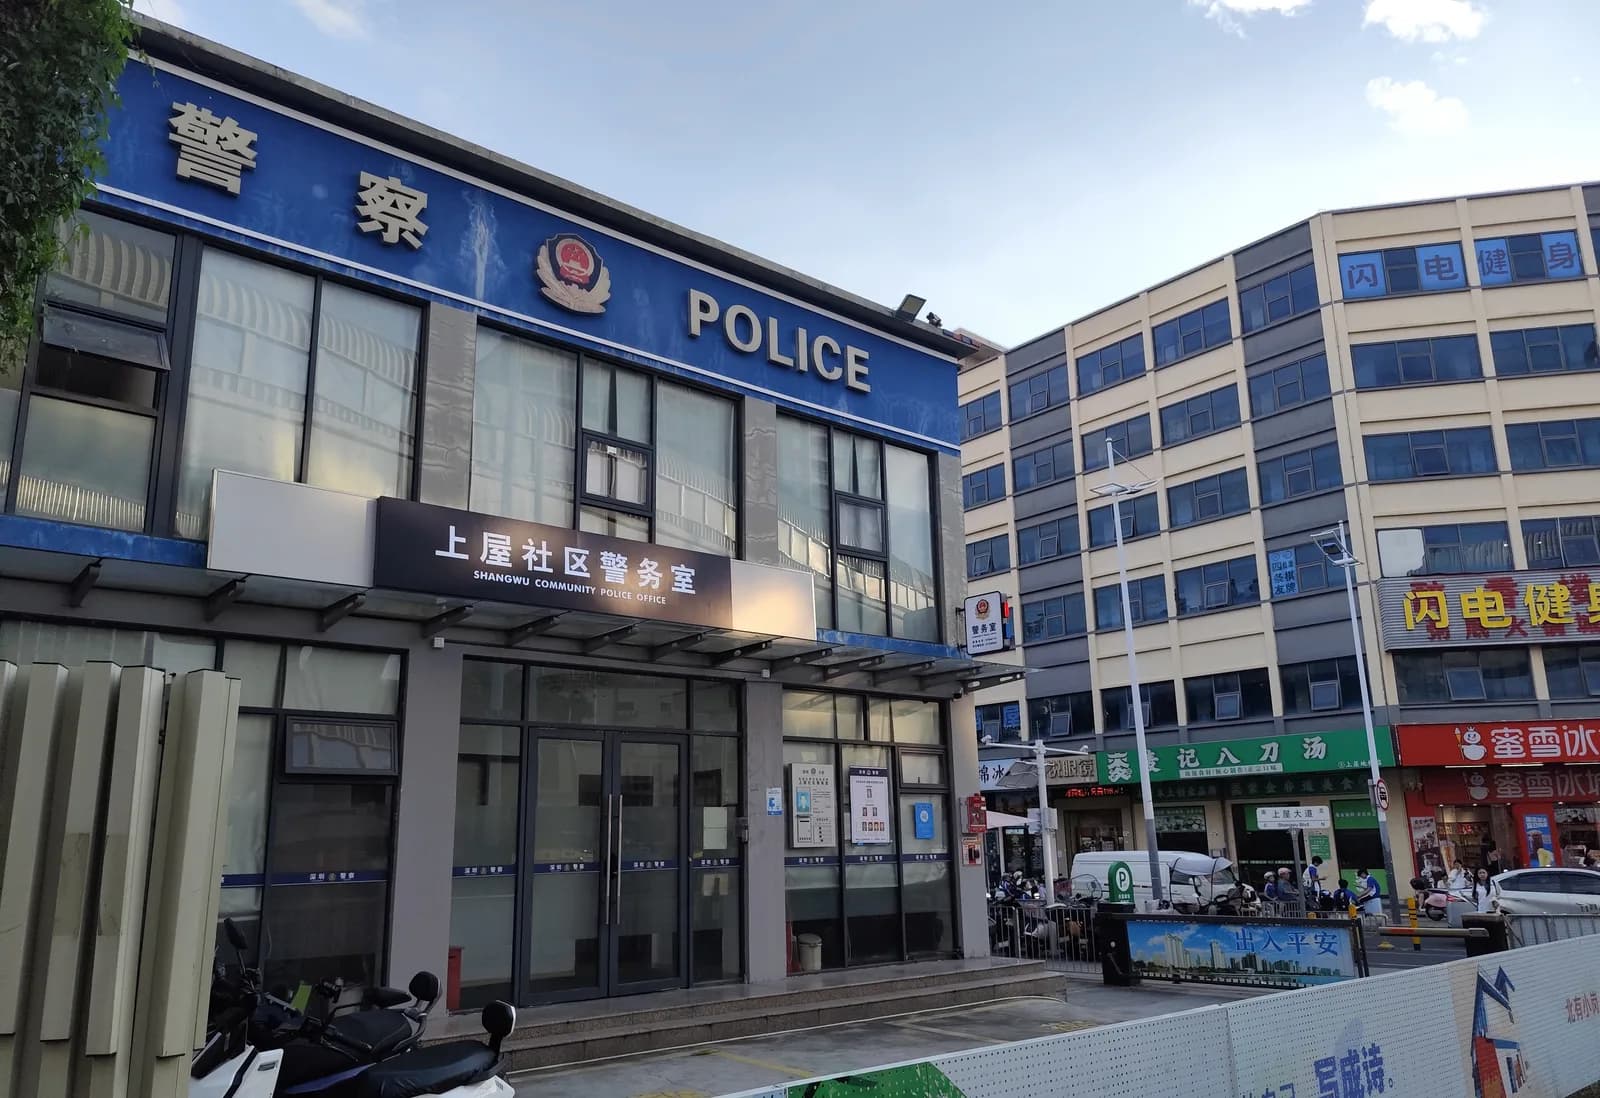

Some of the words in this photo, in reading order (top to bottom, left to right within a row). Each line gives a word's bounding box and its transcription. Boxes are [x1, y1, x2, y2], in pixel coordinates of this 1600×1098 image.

[169, 101, 429, 250] 警察
[1347, 242, 1576, 290] 闪电健身
[687, 288, 872, 393] POLICE
[435, 525, 696, 595] 上屋社区警务室
[473, 570, 530, 586] SHANGWU
[535, 578, 597, 595] COMMUNITY
[600, 588, 633, 601] POLICE
[636, 593, 666, 605] OFFICE
[1403, 583, 1600, 630] 闪电健
[1490, 725, 1600, 759] 蜜雪冰
[1272, 809, 1314, 819] 上屋大道
[1234, 927, 1339, 956] 出入平安
